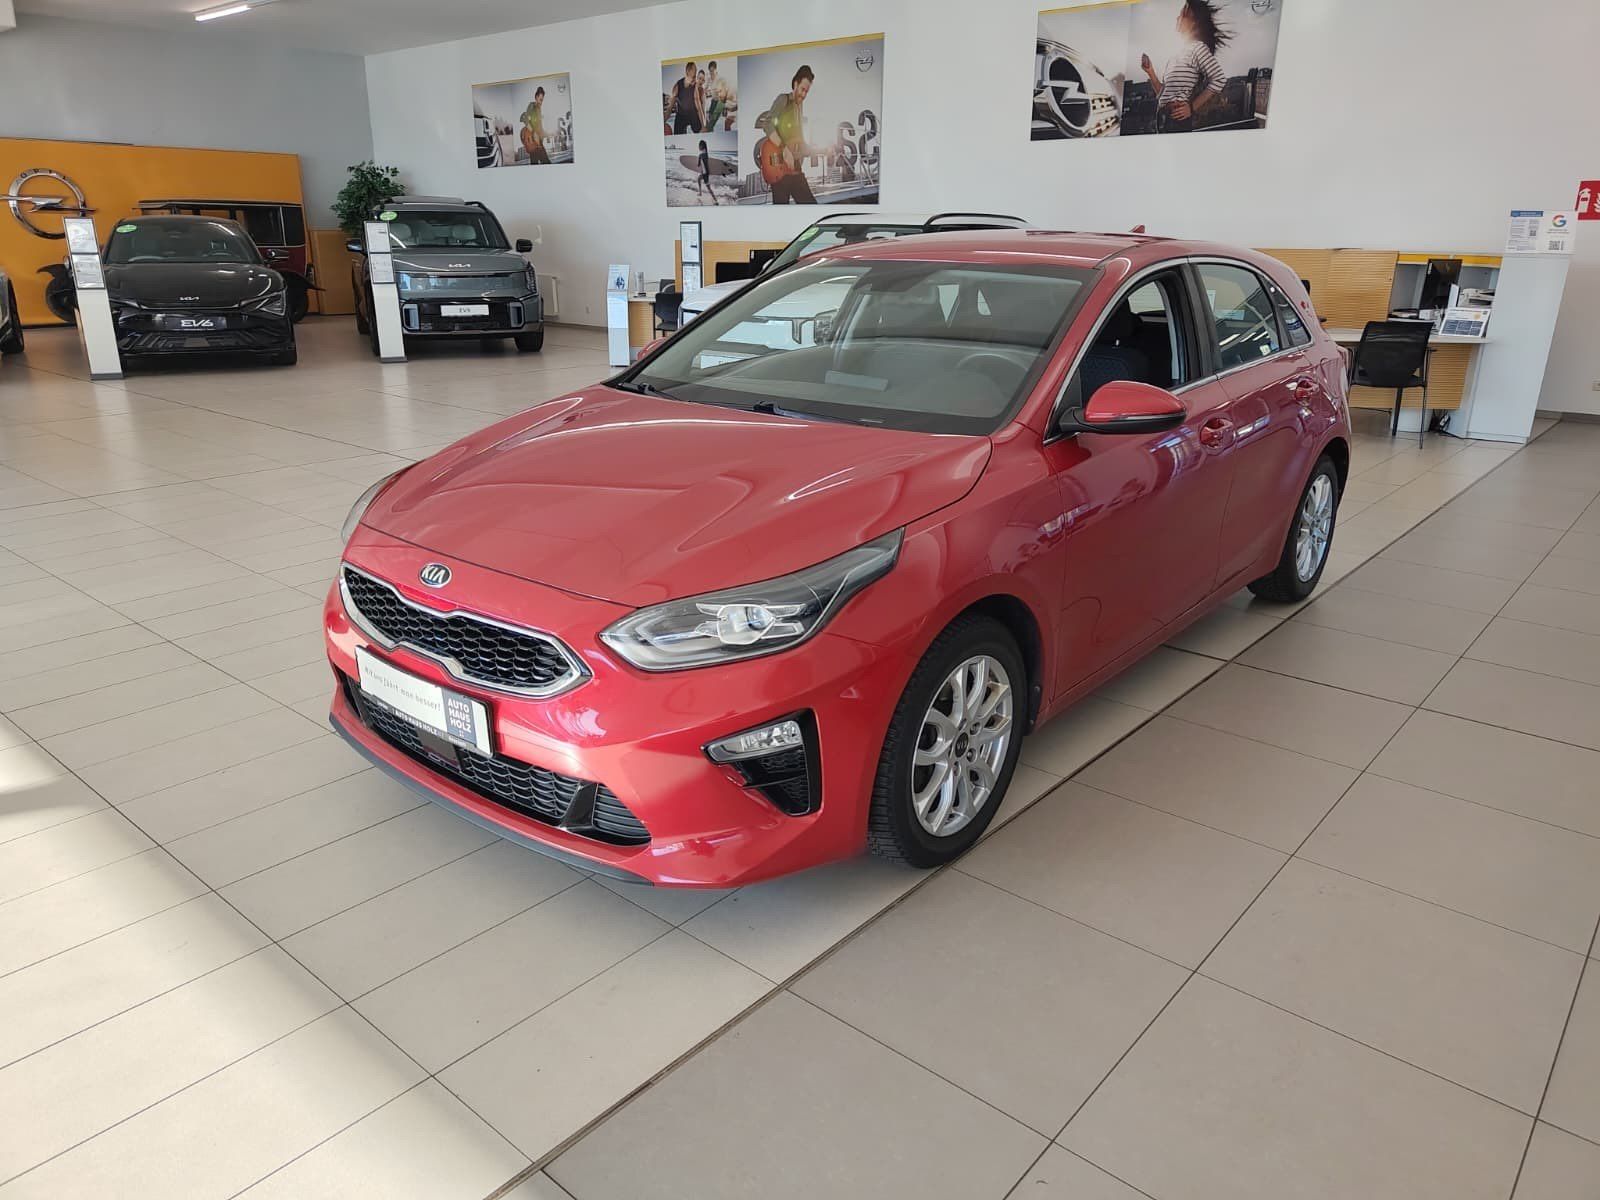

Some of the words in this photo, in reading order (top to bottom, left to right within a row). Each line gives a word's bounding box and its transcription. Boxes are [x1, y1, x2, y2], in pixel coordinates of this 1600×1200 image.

[181, 319, 214, 327] EV6
[421, 566, 445, 583] KIA
[447, 698, 470, 713] AUTO
[448, 707, 471, 723] HAUS
[449, 717, 472, 733] HOLZ
